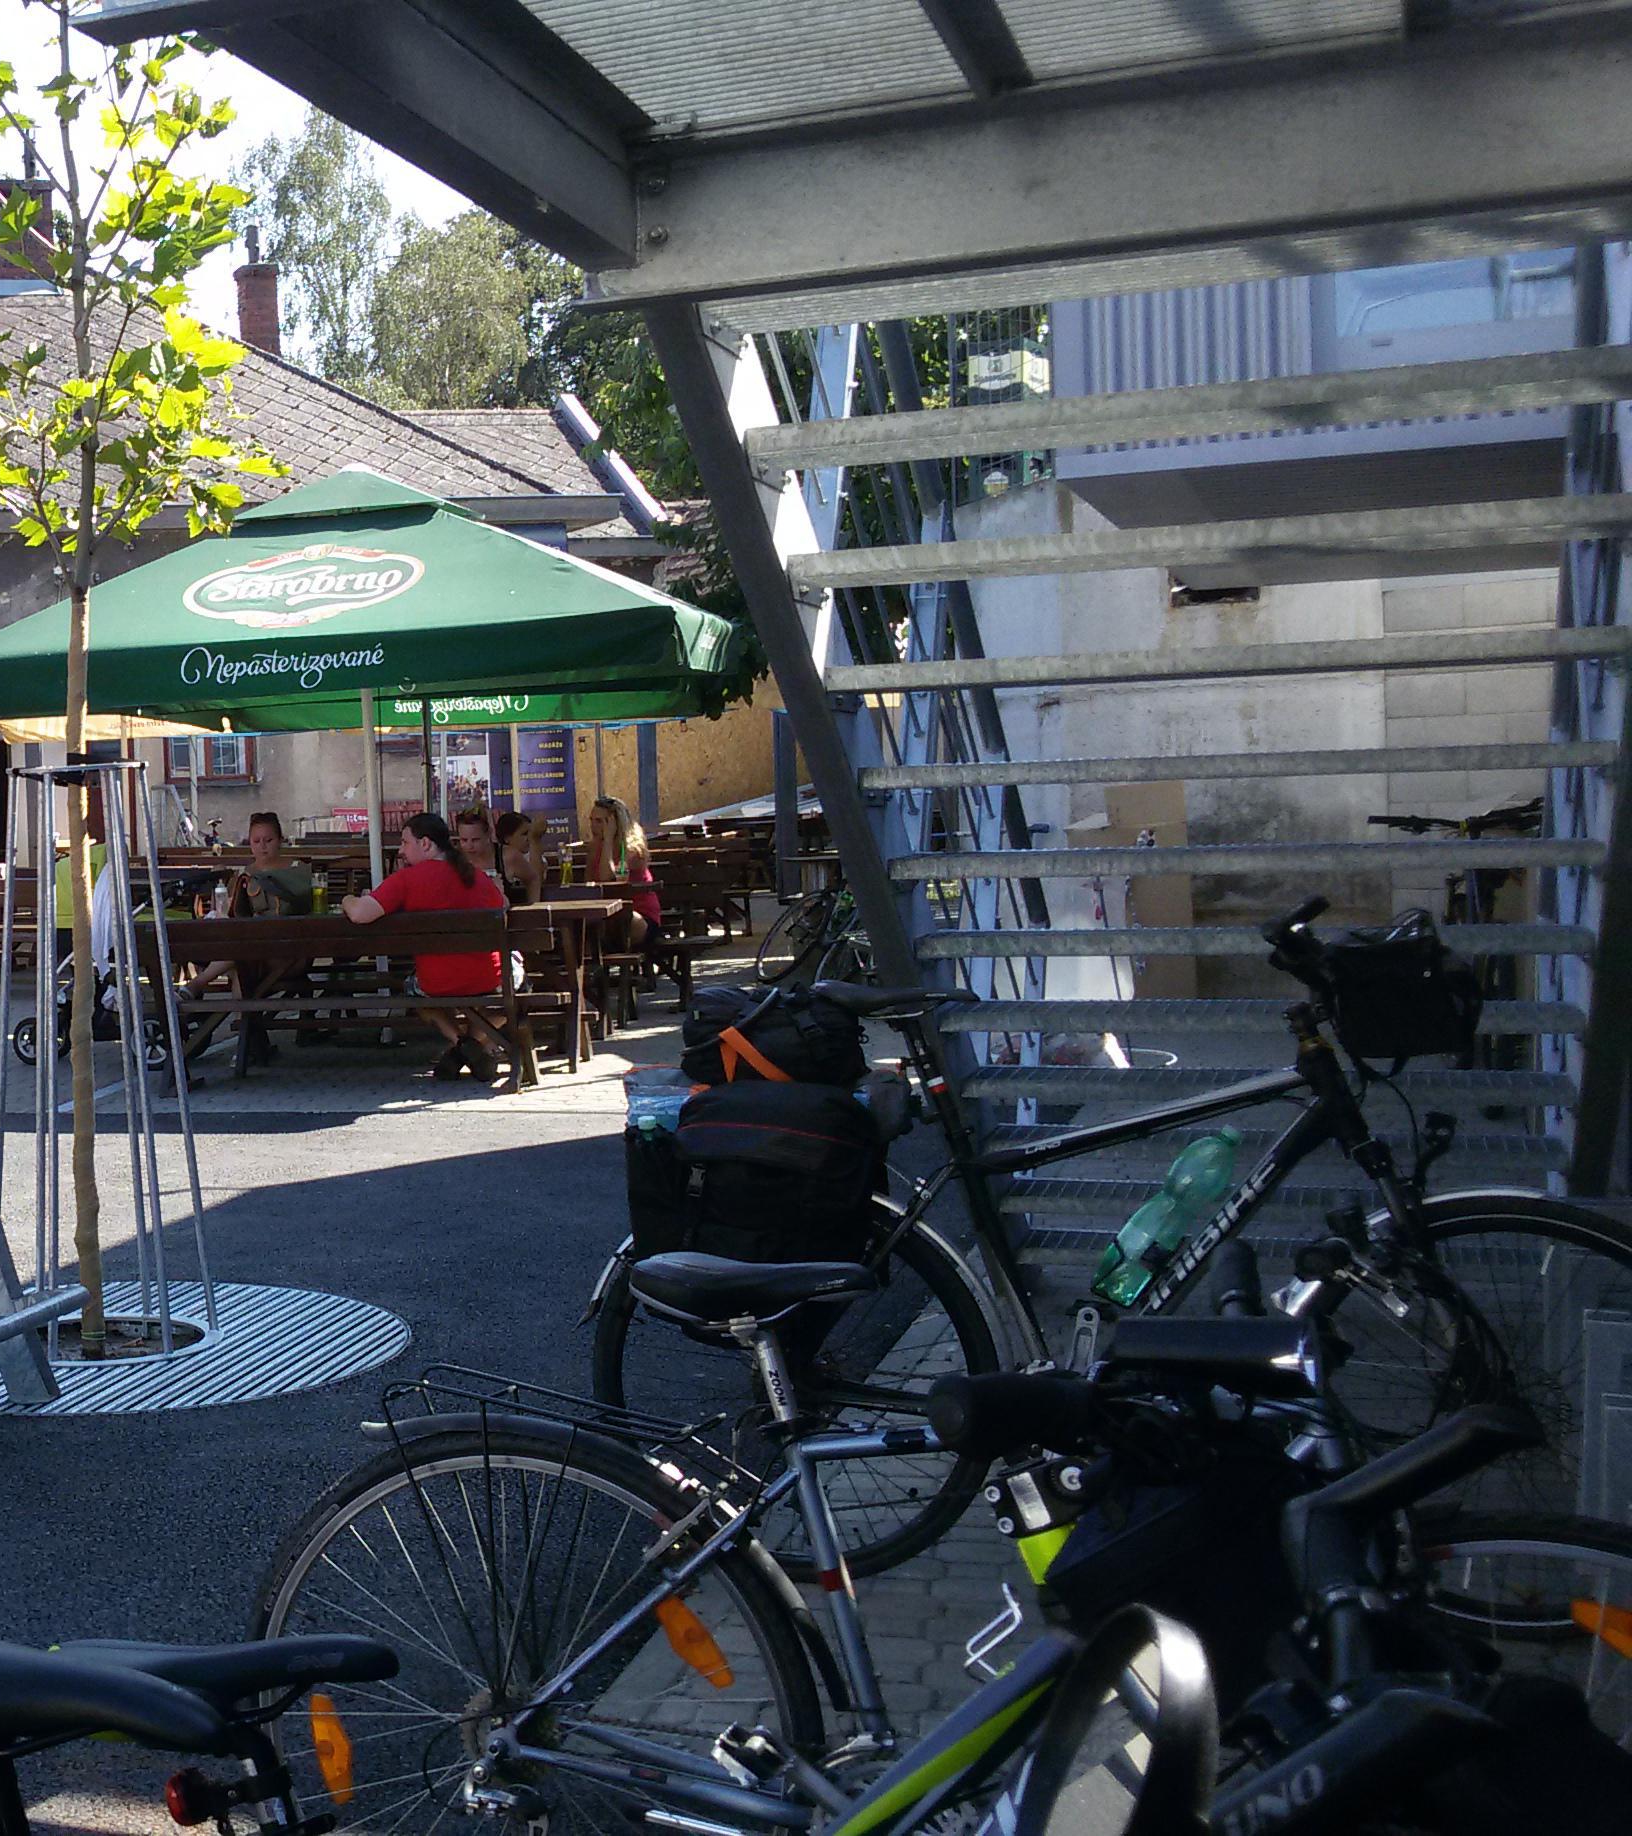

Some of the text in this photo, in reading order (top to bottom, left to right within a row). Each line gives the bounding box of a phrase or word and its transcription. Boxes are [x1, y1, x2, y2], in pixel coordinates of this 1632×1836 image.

[208, 565, 403, 606] Starobrno
[180, 643, 385, 689] Nepasterizované
[768, 1370, 788, 1407] ZOOM
